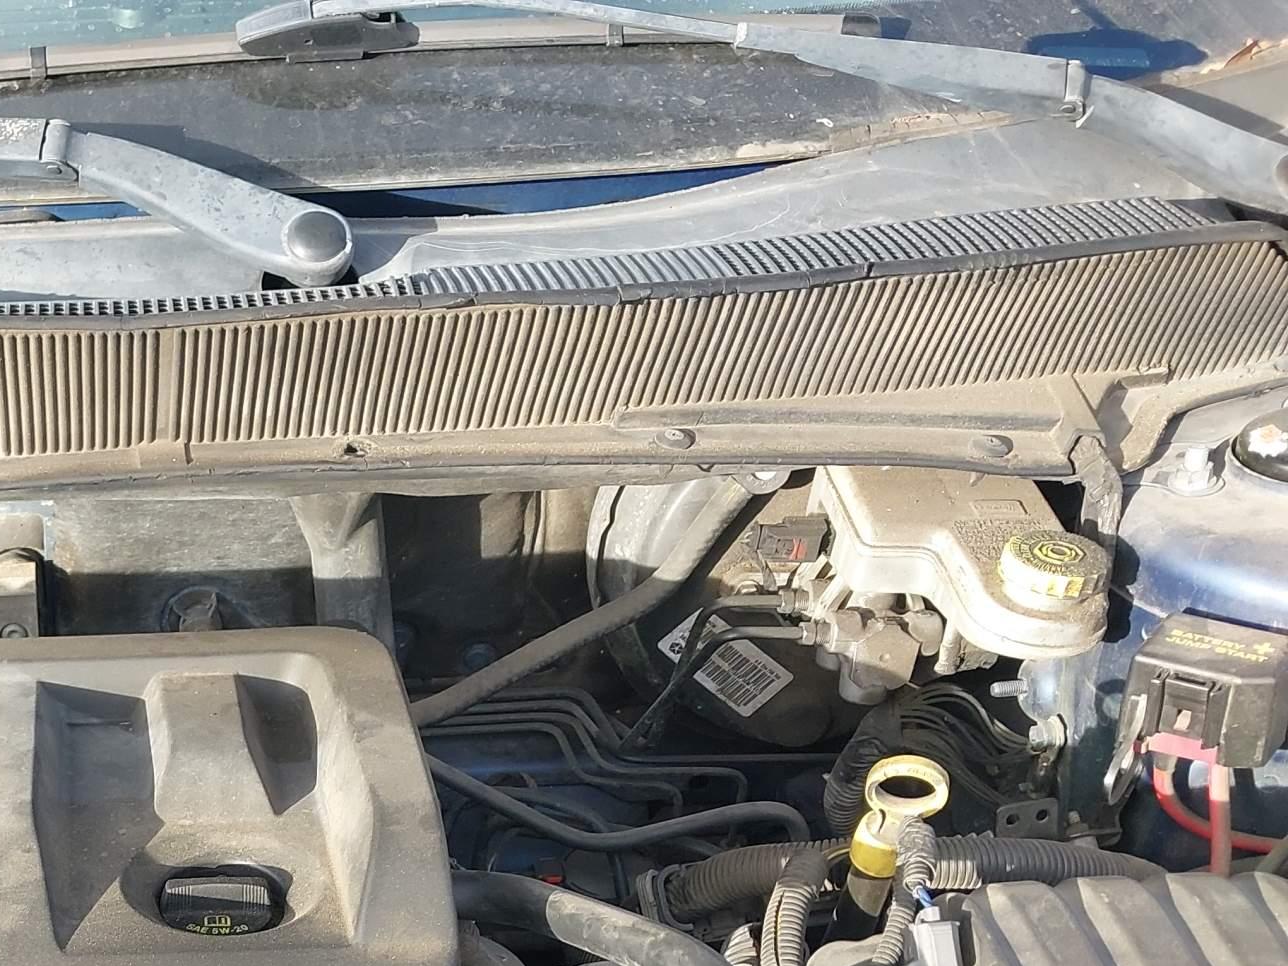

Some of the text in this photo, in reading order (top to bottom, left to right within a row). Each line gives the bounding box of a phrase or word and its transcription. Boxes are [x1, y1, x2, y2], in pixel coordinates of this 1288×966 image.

[1164, 636, 1270, 663] JUMP START
[1169, 628, 1247, 650] BATTERY
[185, 923, 250, 935] SAE 5W-20
